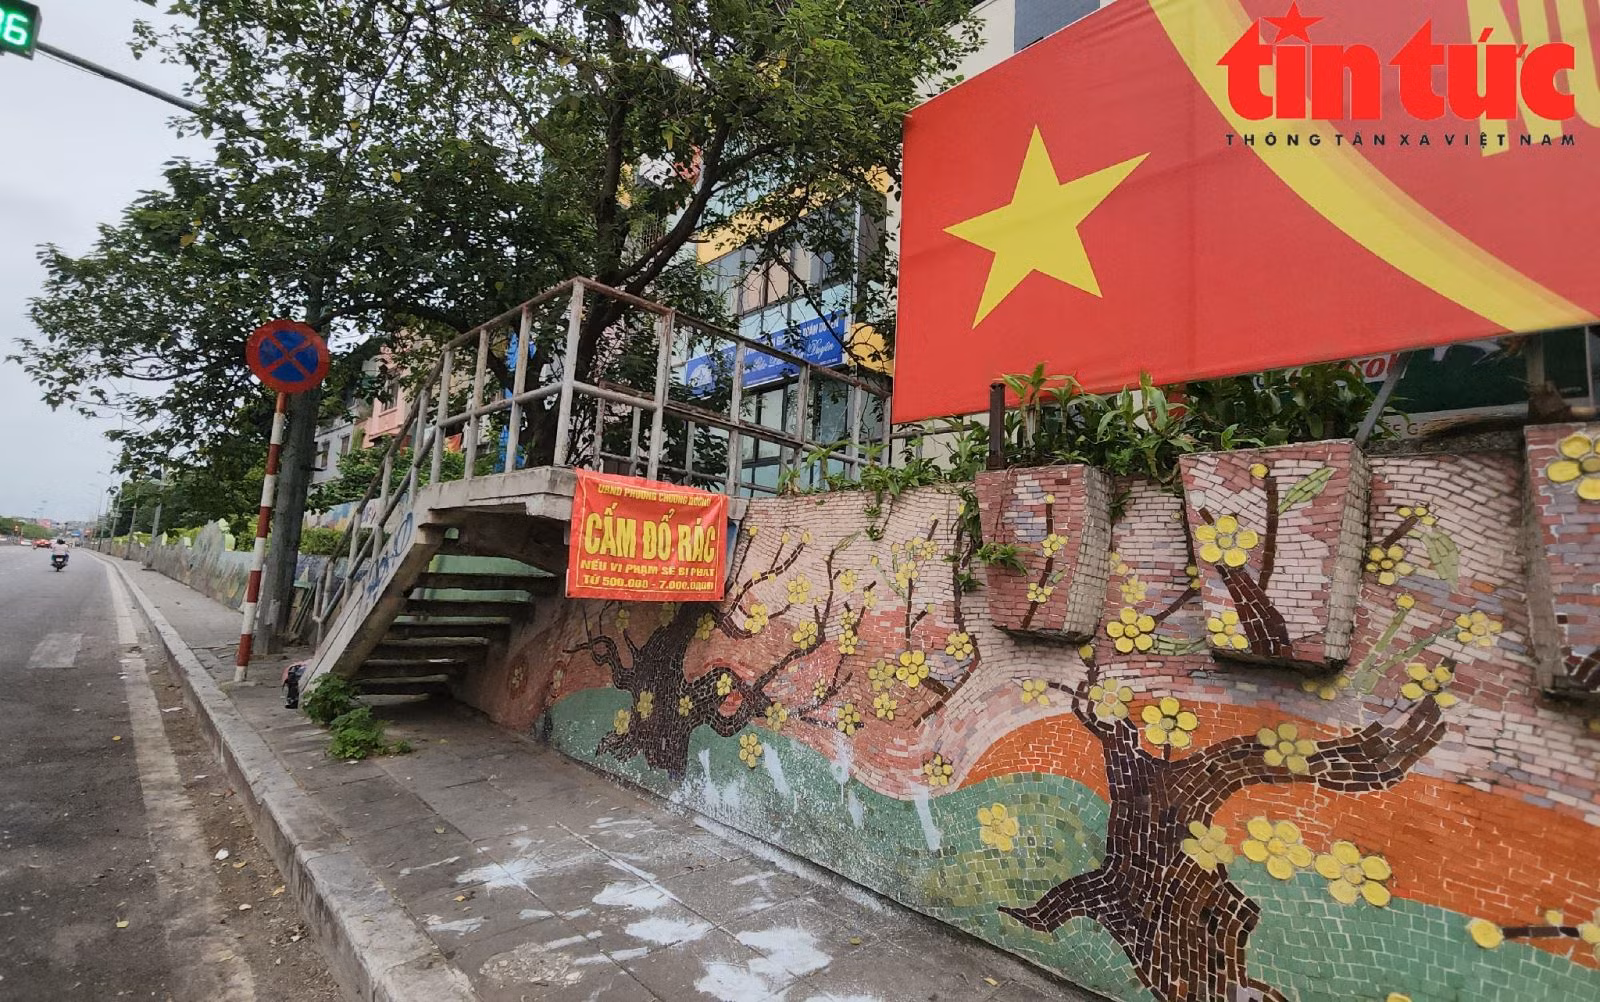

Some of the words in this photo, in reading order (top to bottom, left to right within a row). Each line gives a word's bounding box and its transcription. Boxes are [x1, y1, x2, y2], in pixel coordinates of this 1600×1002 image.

[0, 8, 28, 45] 6
[584, 502, 636, 559] CẤM
[642, 508, 675, 561] ĐỔ
[677, 518, 716, 563] RÁC
[580, 559, 607, 571] NẾU
[610, 562, 622, 572] VI
[625, 564, 658, 576] PHẠM
[602, 576, 649, 589] 500.000
